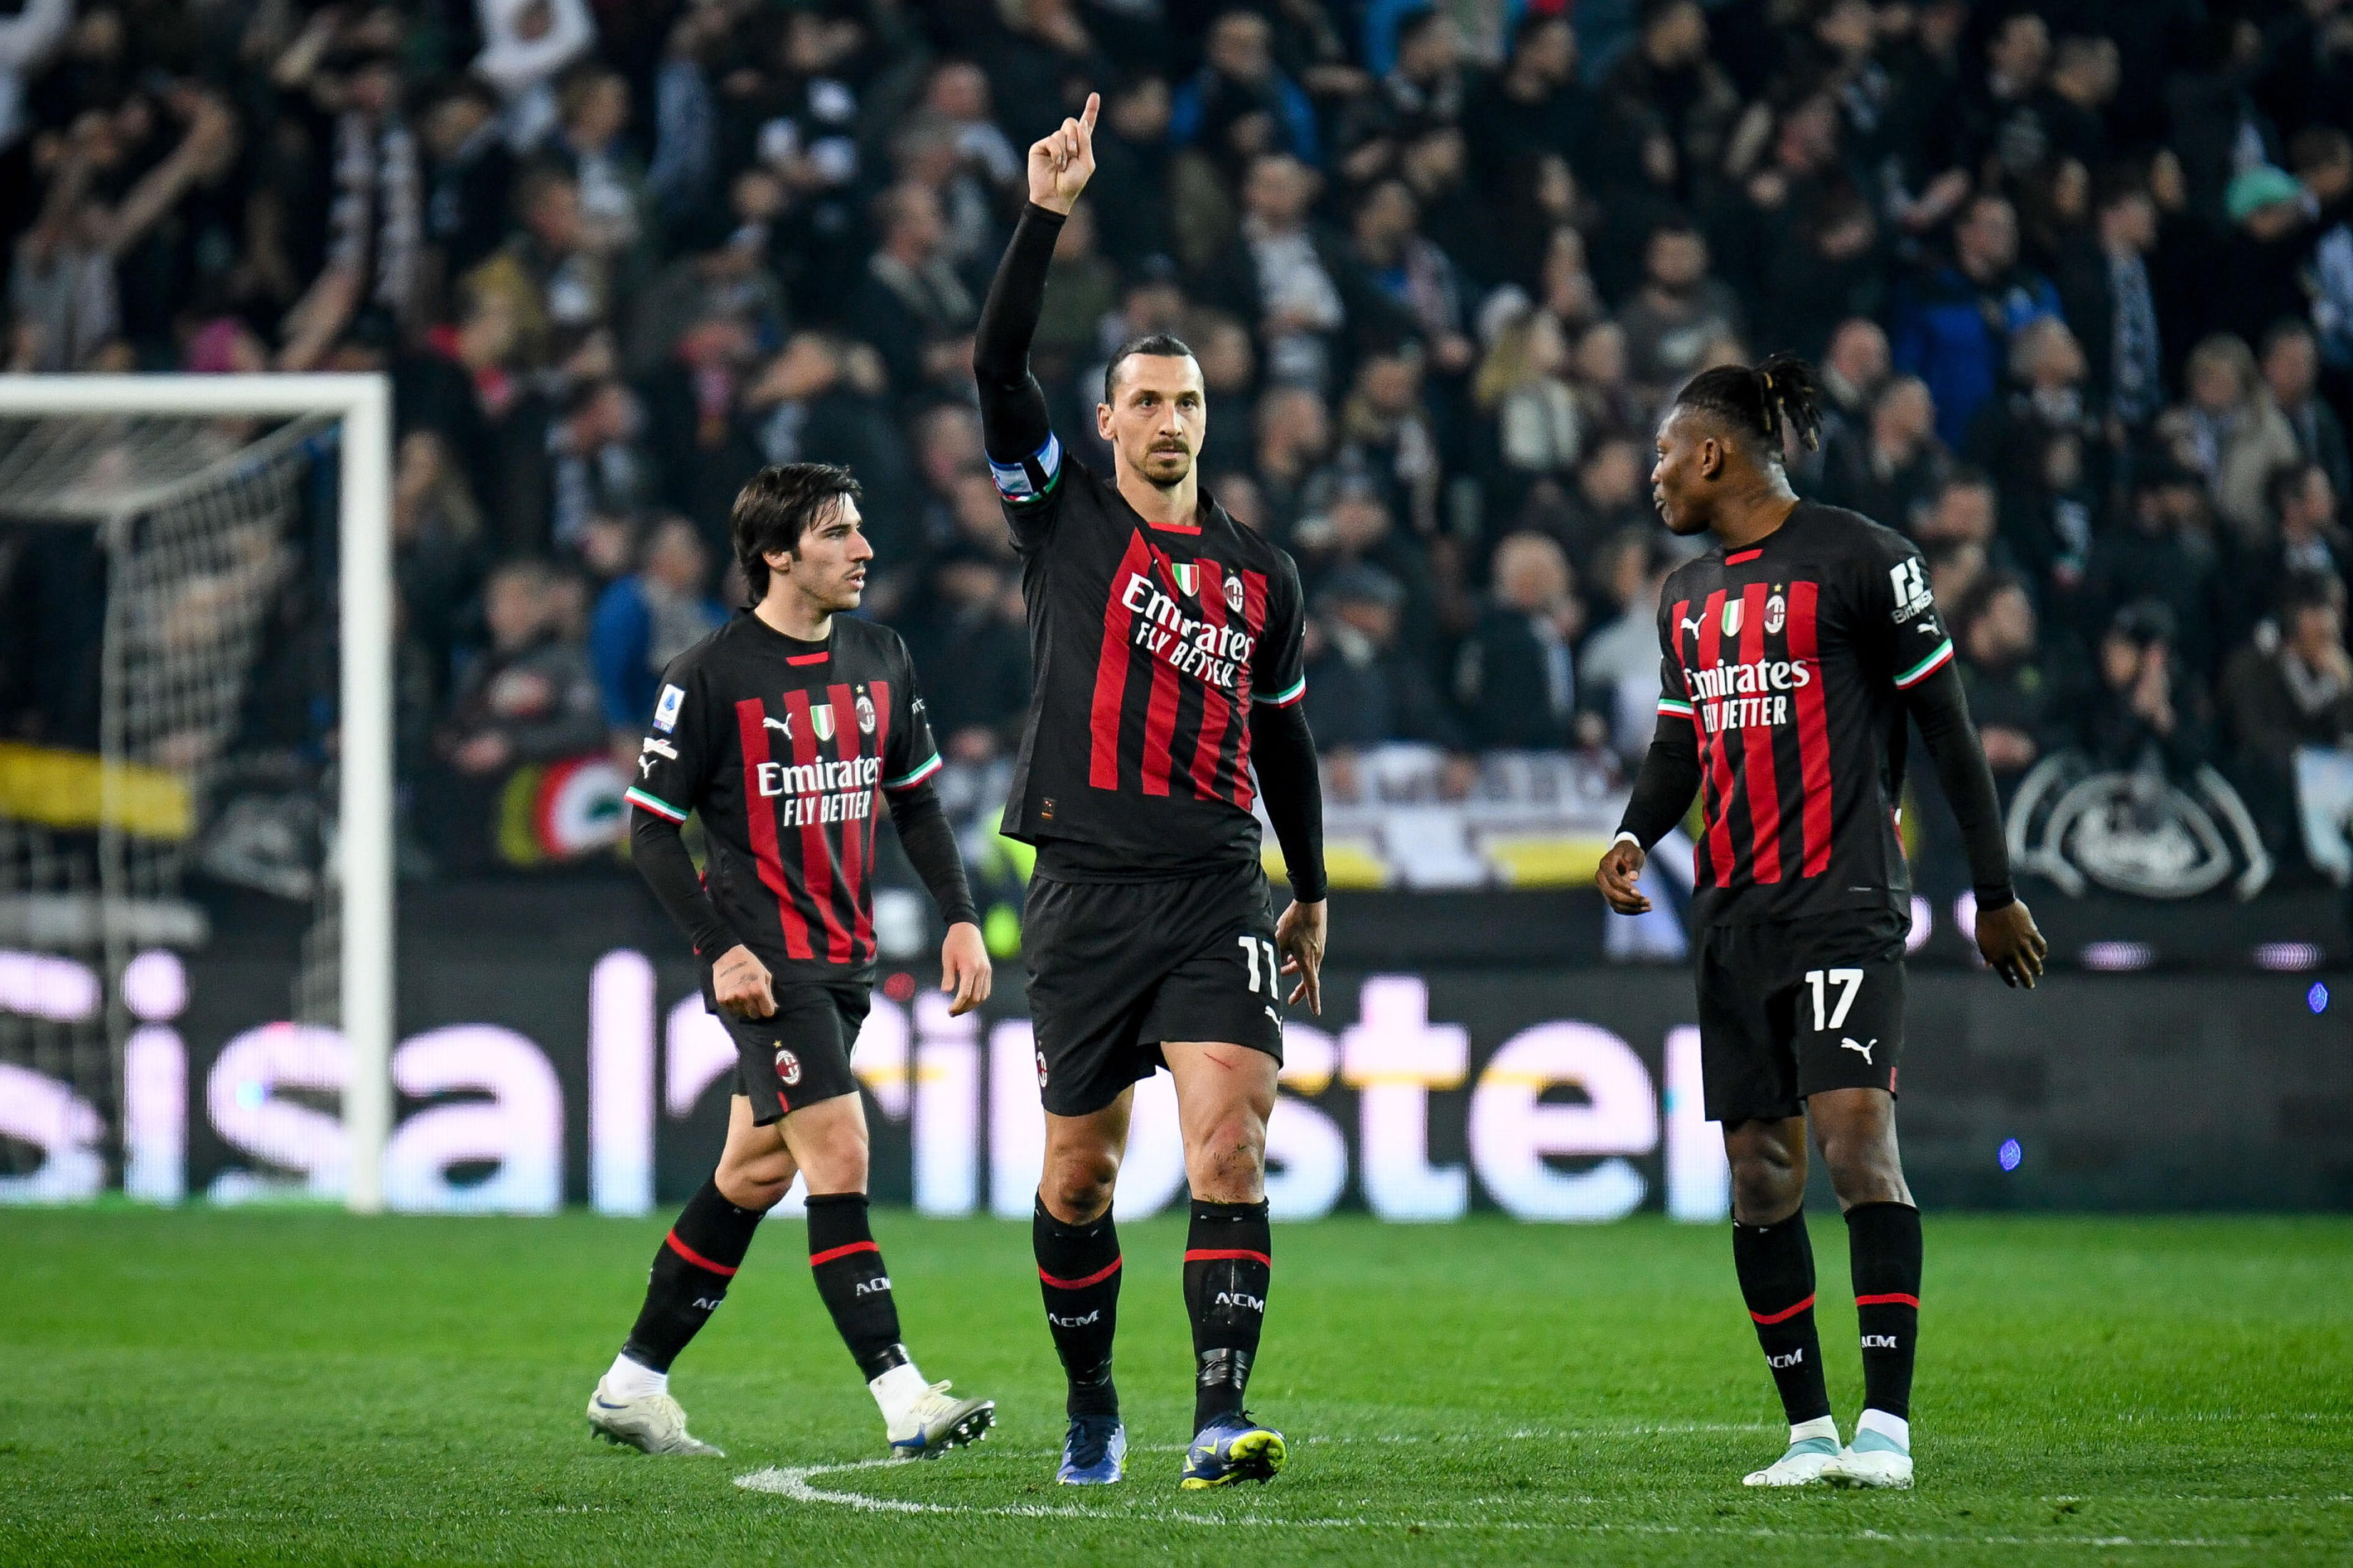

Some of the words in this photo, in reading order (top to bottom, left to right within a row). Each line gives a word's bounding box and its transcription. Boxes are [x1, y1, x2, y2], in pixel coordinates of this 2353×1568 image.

[1135, 621, 1172, 654] FLY
[1168, 640, 1234, 688] BETTER
[1684, 659, 1810, 702] Emirates
[784, 797, 816, 827] FLY
[819, 790, 871, 823] BETTER
[1238, 936, 1279, 1000] 11
[1805, 968, 1864, 1032] 17
[1049, 1310, 1099, 1328] ACM
[1214, 1291, 1265, 1314] ACM
